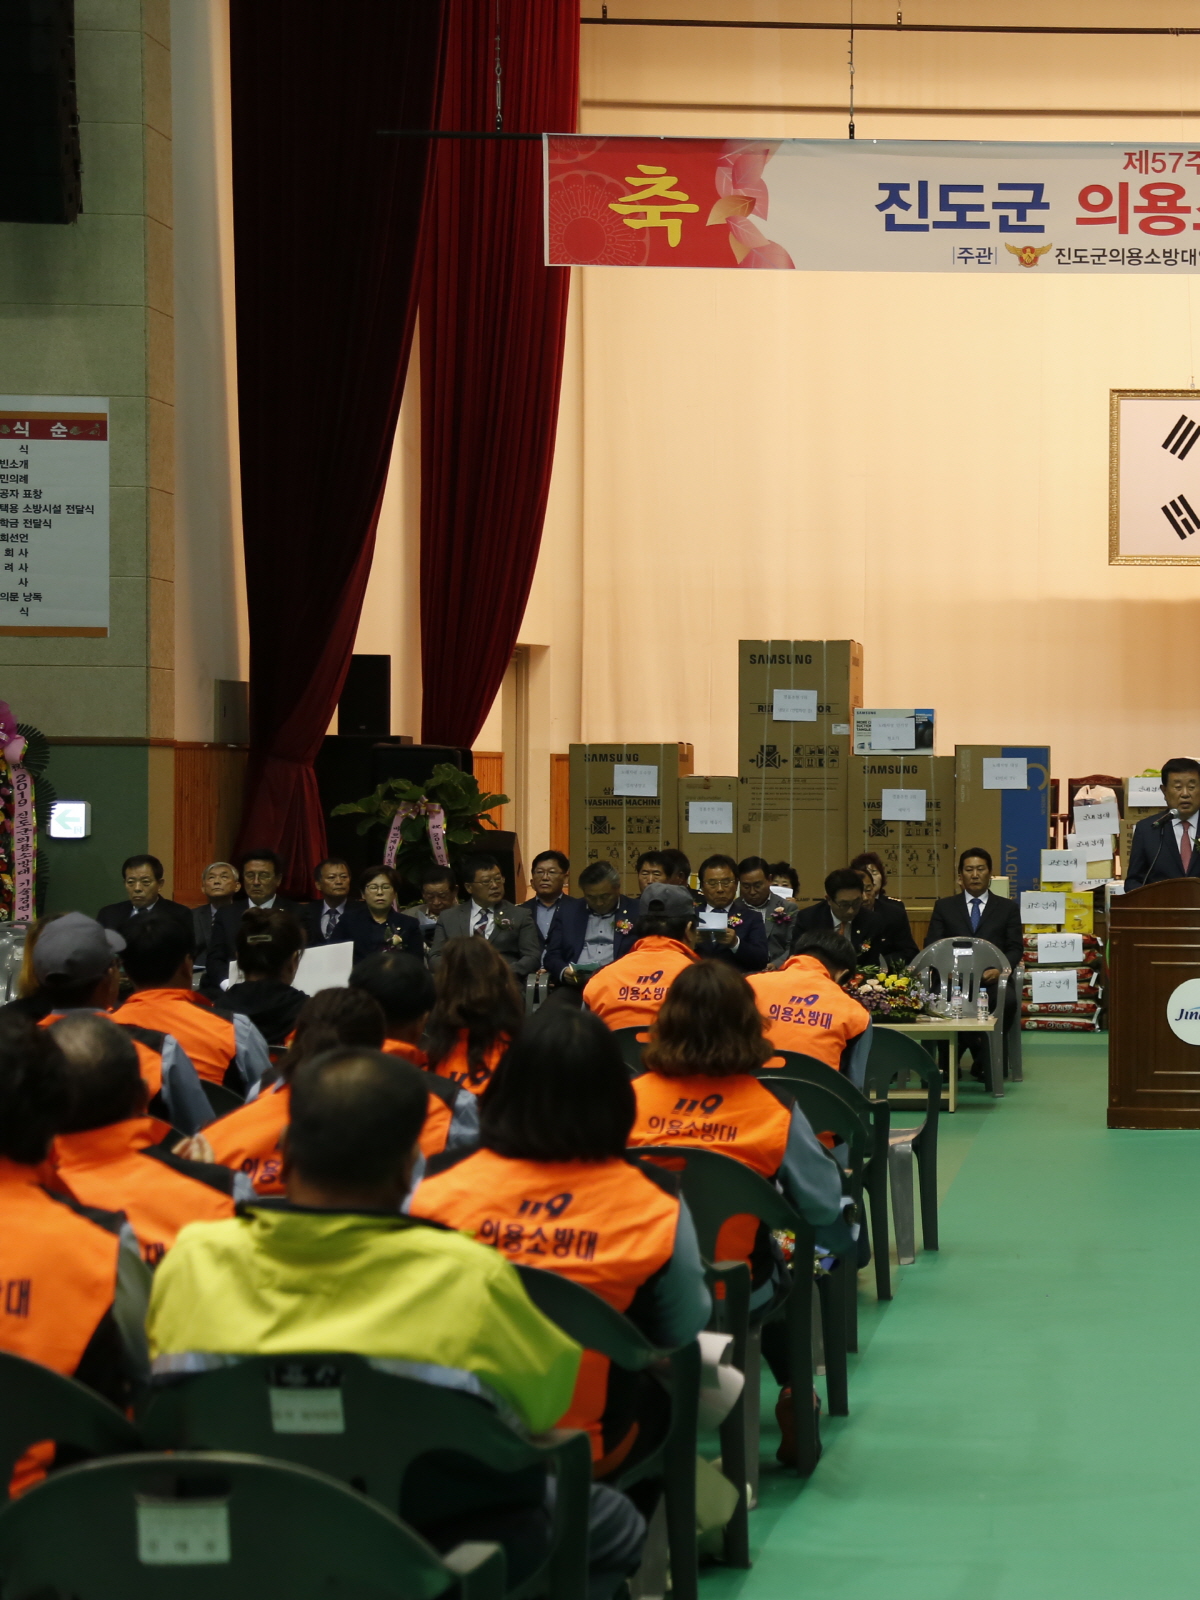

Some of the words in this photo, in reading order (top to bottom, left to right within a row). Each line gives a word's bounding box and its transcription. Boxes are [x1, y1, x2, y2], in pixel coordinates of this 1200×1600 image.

[608, 164, 700, 248] 축
[874, 179, 1051, 235] 진도군
[956, 246, 993, 266] 주관
[22, 489, 43, 500] 표창
[22, 504, 62, 514] 소방시설
[65, 504, 95, 514] 전달식
[22, 518, 52, 529] 전달식
[22, 592, 43, 602] 낭독
[749, 654, 813, 665] SAMSUNG
[584, 753, 639, 763] SAMSUNG
[863, 765, 918, 774] SAMSUNG
[16, 773, 28, 807] 2019
[636, 970, 664, 985] 119
[617, 986, 670, 1001] 의용소방
[788, 993, 820, 1007] 119
[767, 1003, 833, 1030] 의용소방대
[671, 1093, 724, 1118] 119
[646, 1115, 738, 1143] 의용소방대
[515, 1192, 573, 1220] 119
[480, 1219, 598, 1262] 의용소방대
